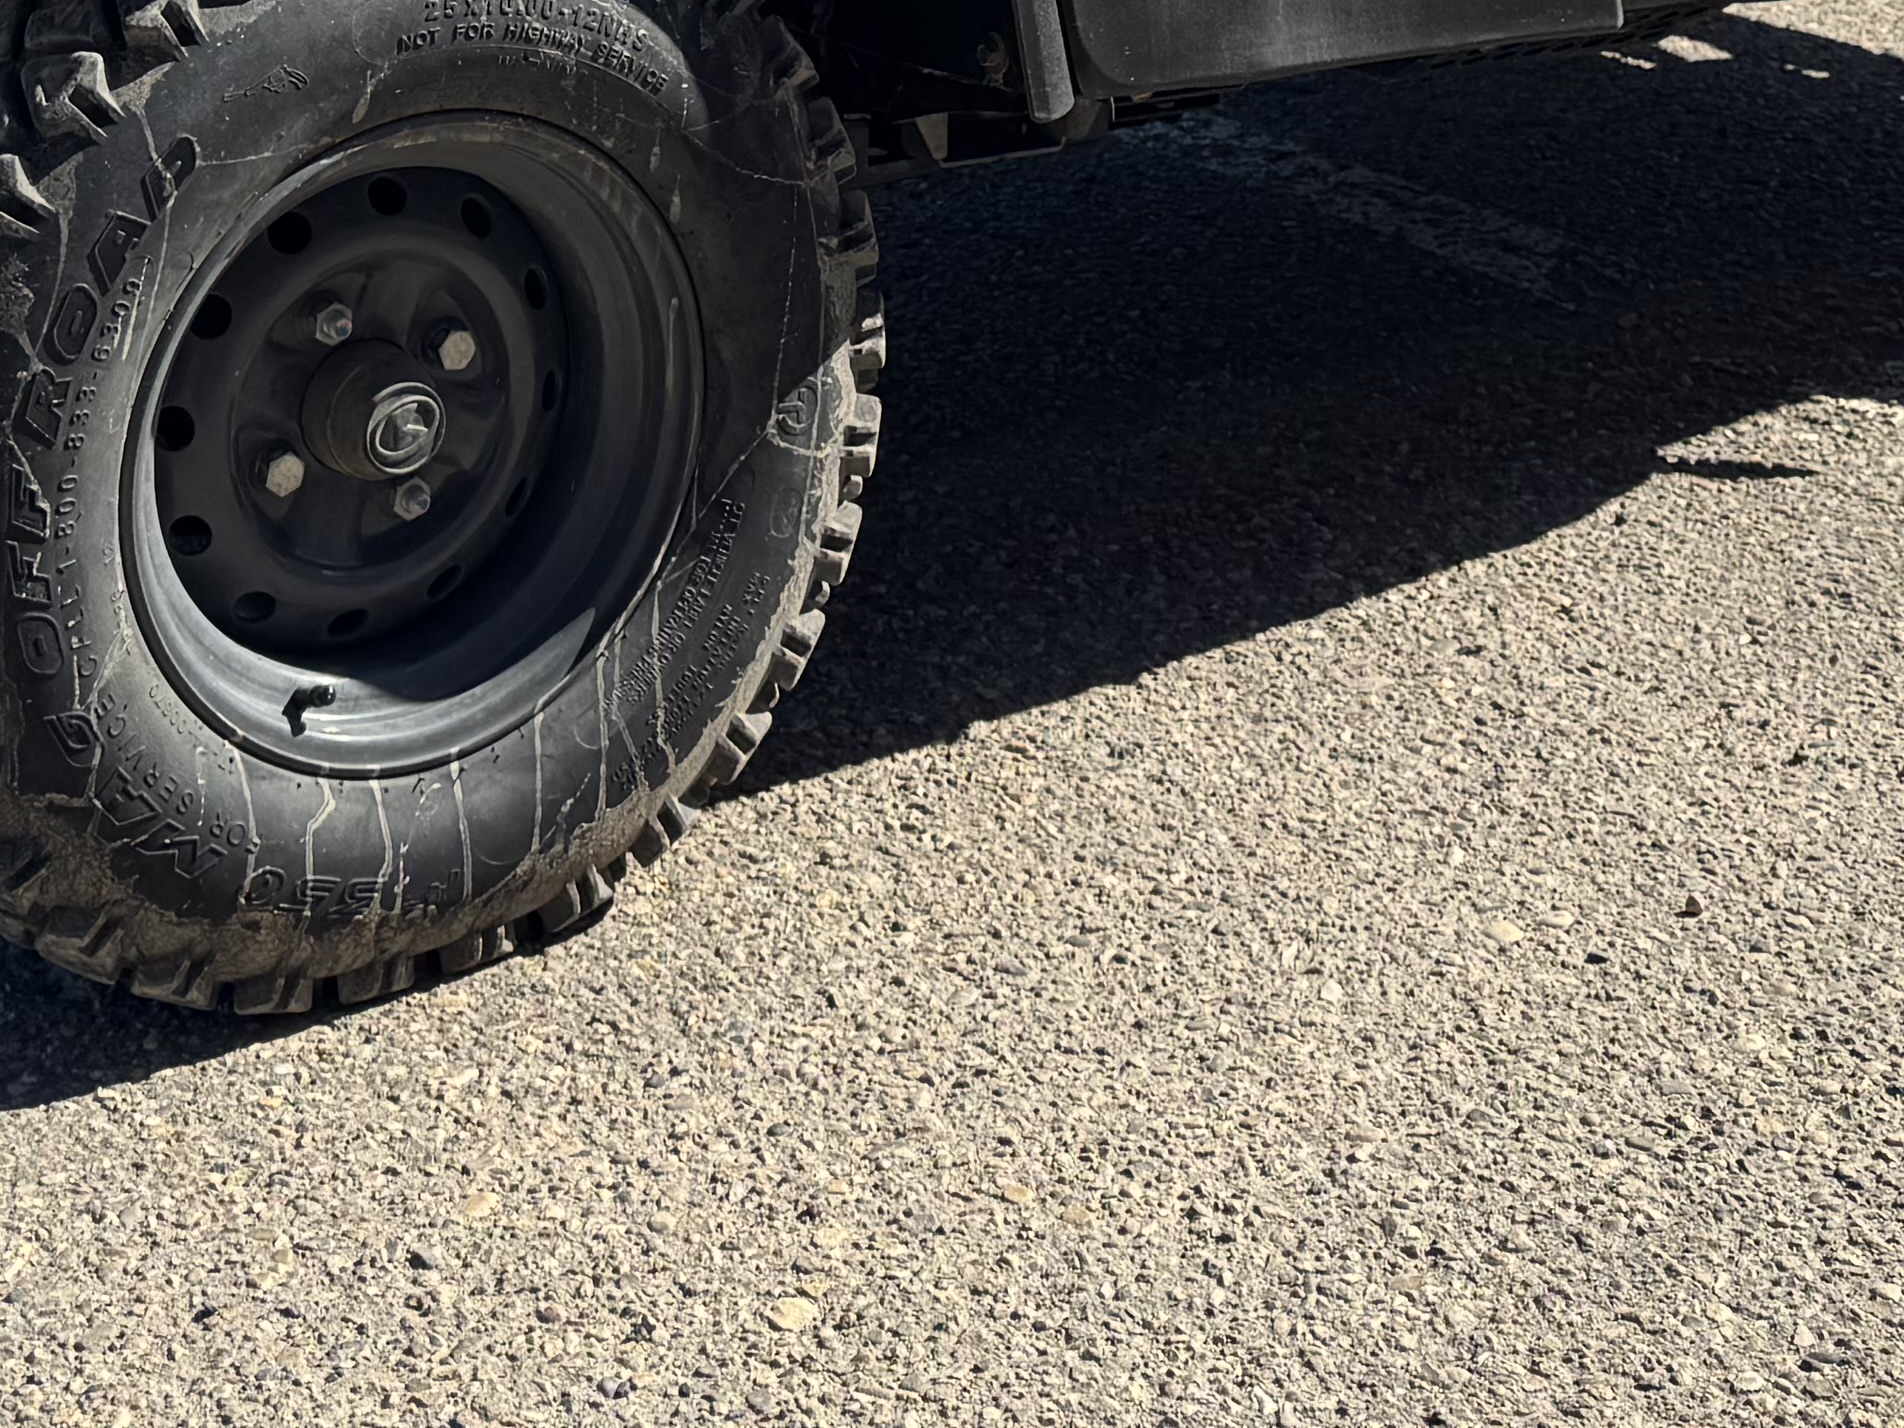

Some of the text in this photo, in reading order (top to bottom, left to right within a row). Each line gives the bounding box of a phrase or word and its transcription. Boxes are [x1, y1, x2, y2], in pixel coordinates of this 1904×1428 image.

[396, 28, 441, 56] NOT
[451, 22, 495, 44] FOR
[595, 41, 670, 96] SERVICE
[22, 133, 202, 445] ROAD
[5, 463, 66, 676] OFF
[93, 692, 195, 815] SERVICE
